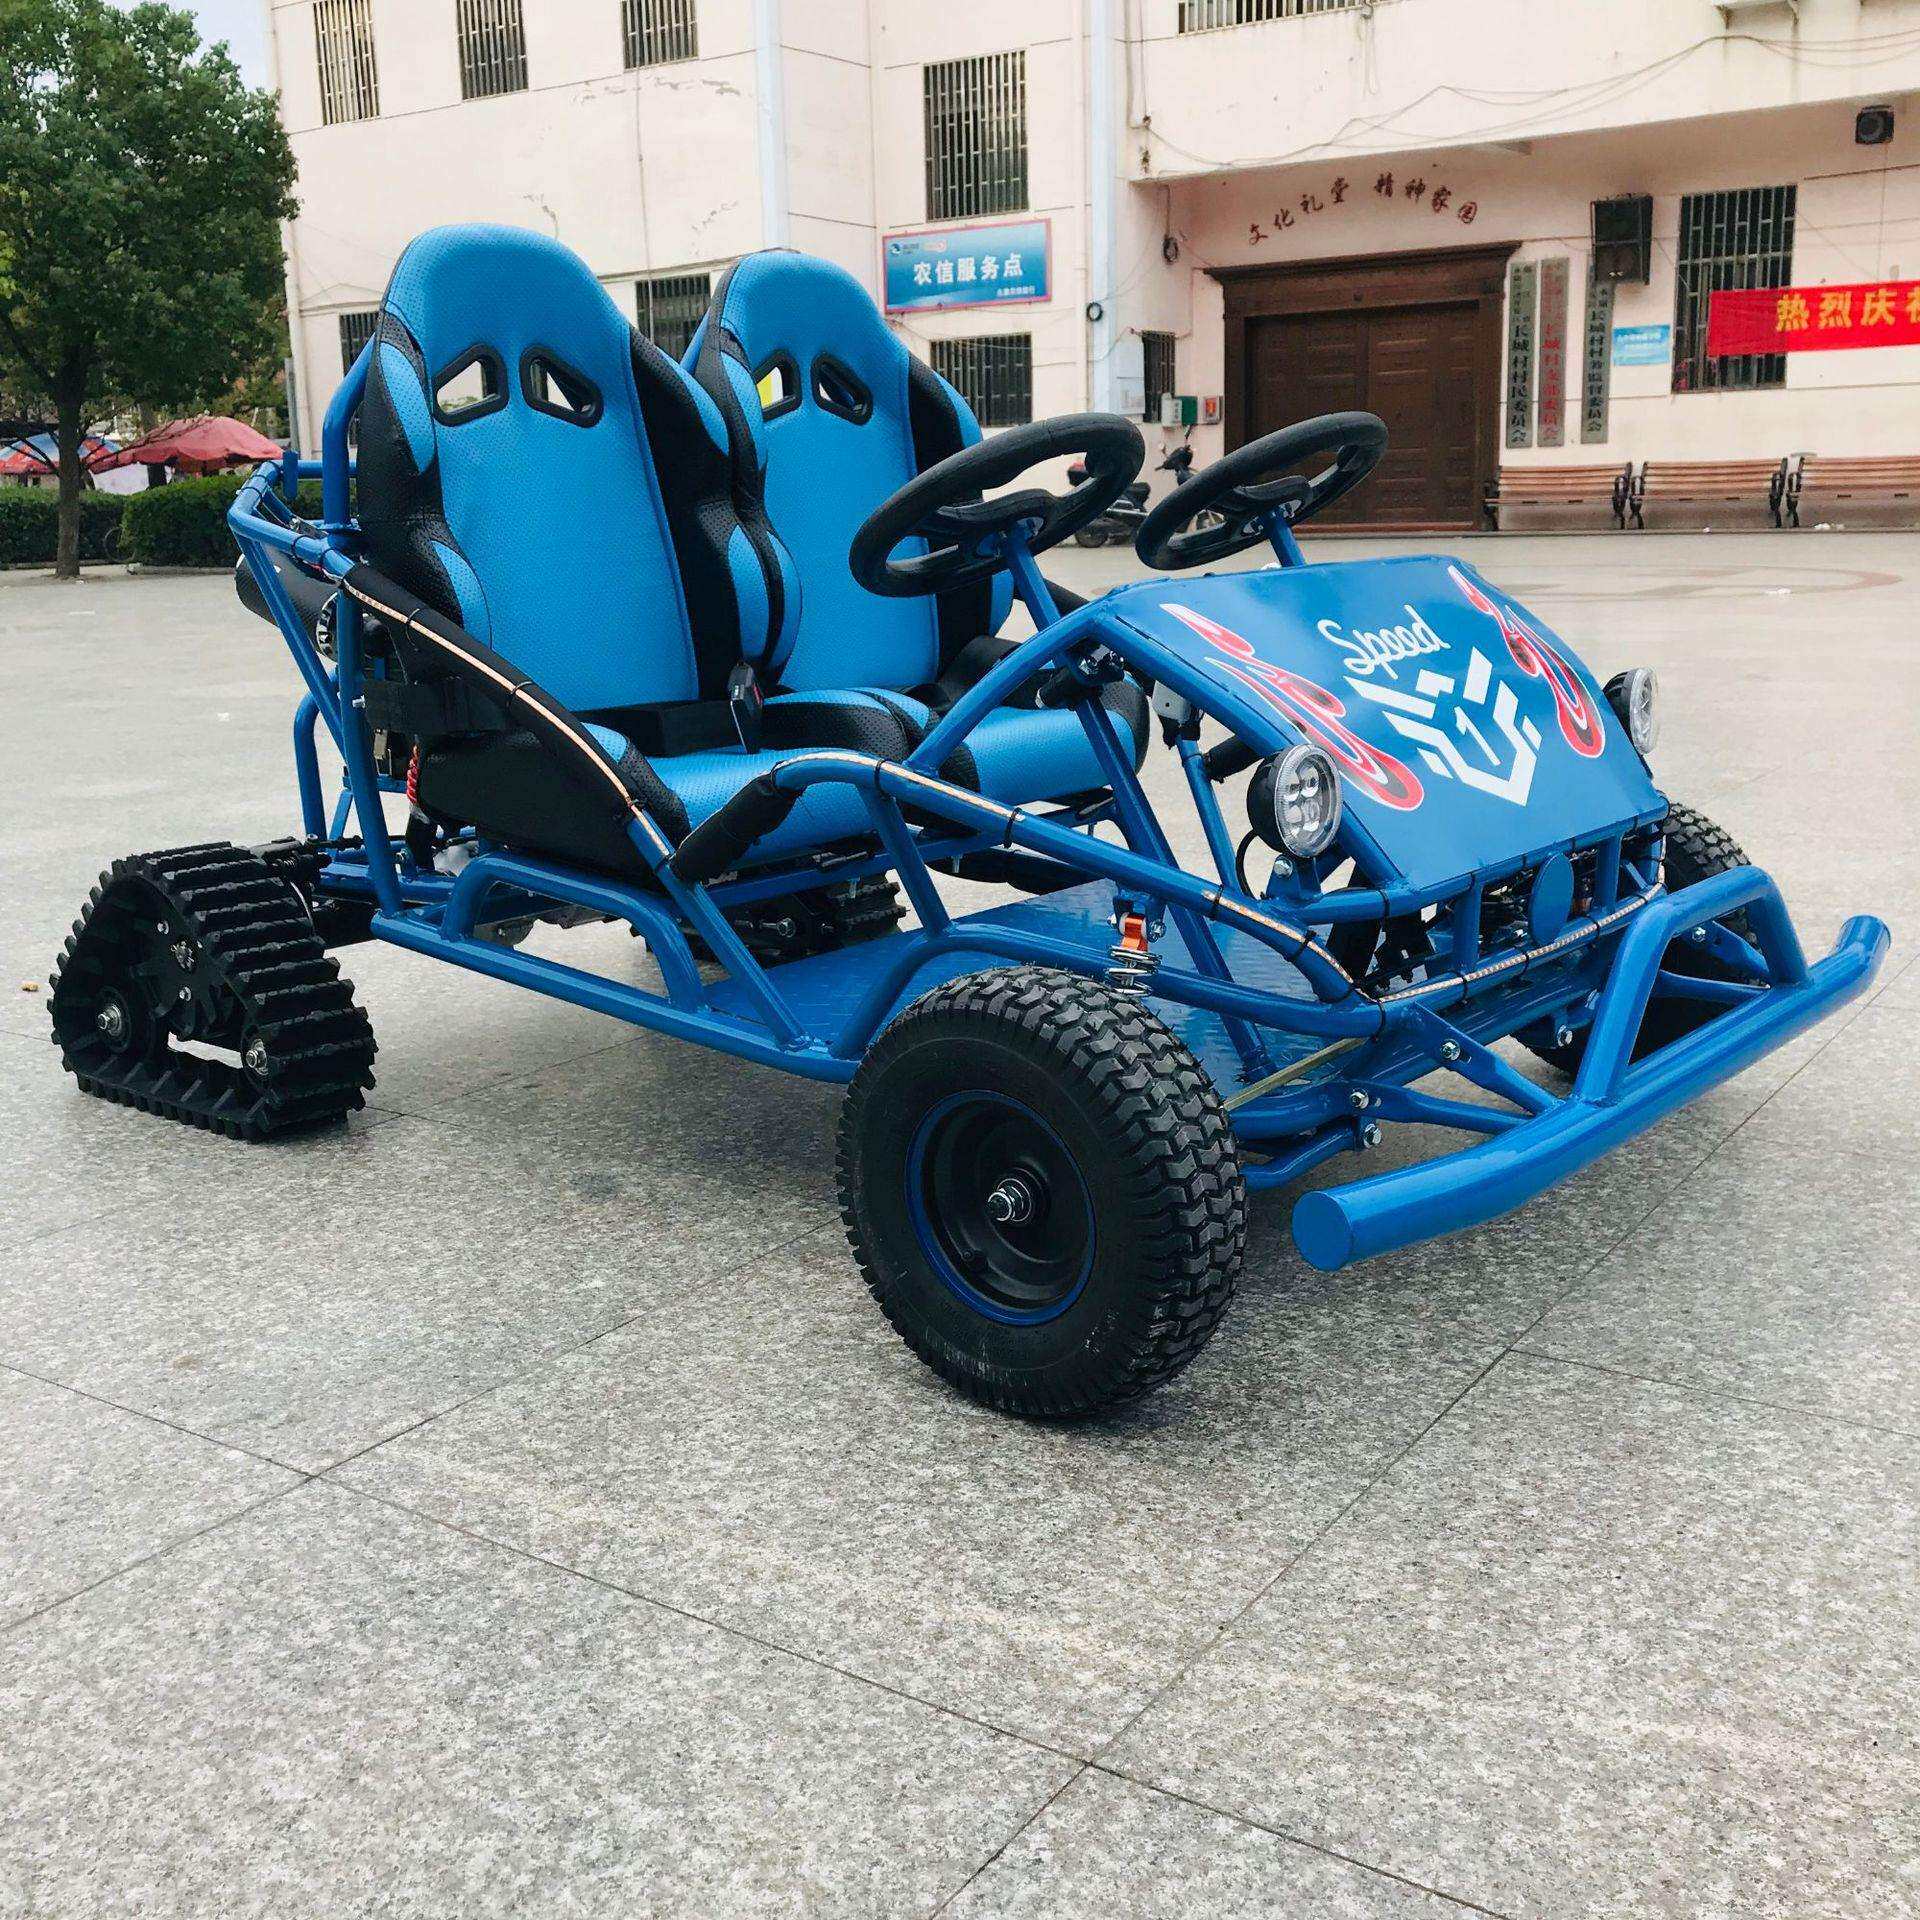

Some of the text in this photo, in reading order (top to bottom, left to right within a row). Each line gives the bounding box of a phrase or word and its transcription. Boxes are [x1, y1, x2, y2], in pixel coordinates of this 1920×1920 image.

[1249, 171, 1478, 246] 文化礼堂 精神家园
[913, 252, 1024, 286] 农信服务点
[1317, 604, 1452, 680] Speed
